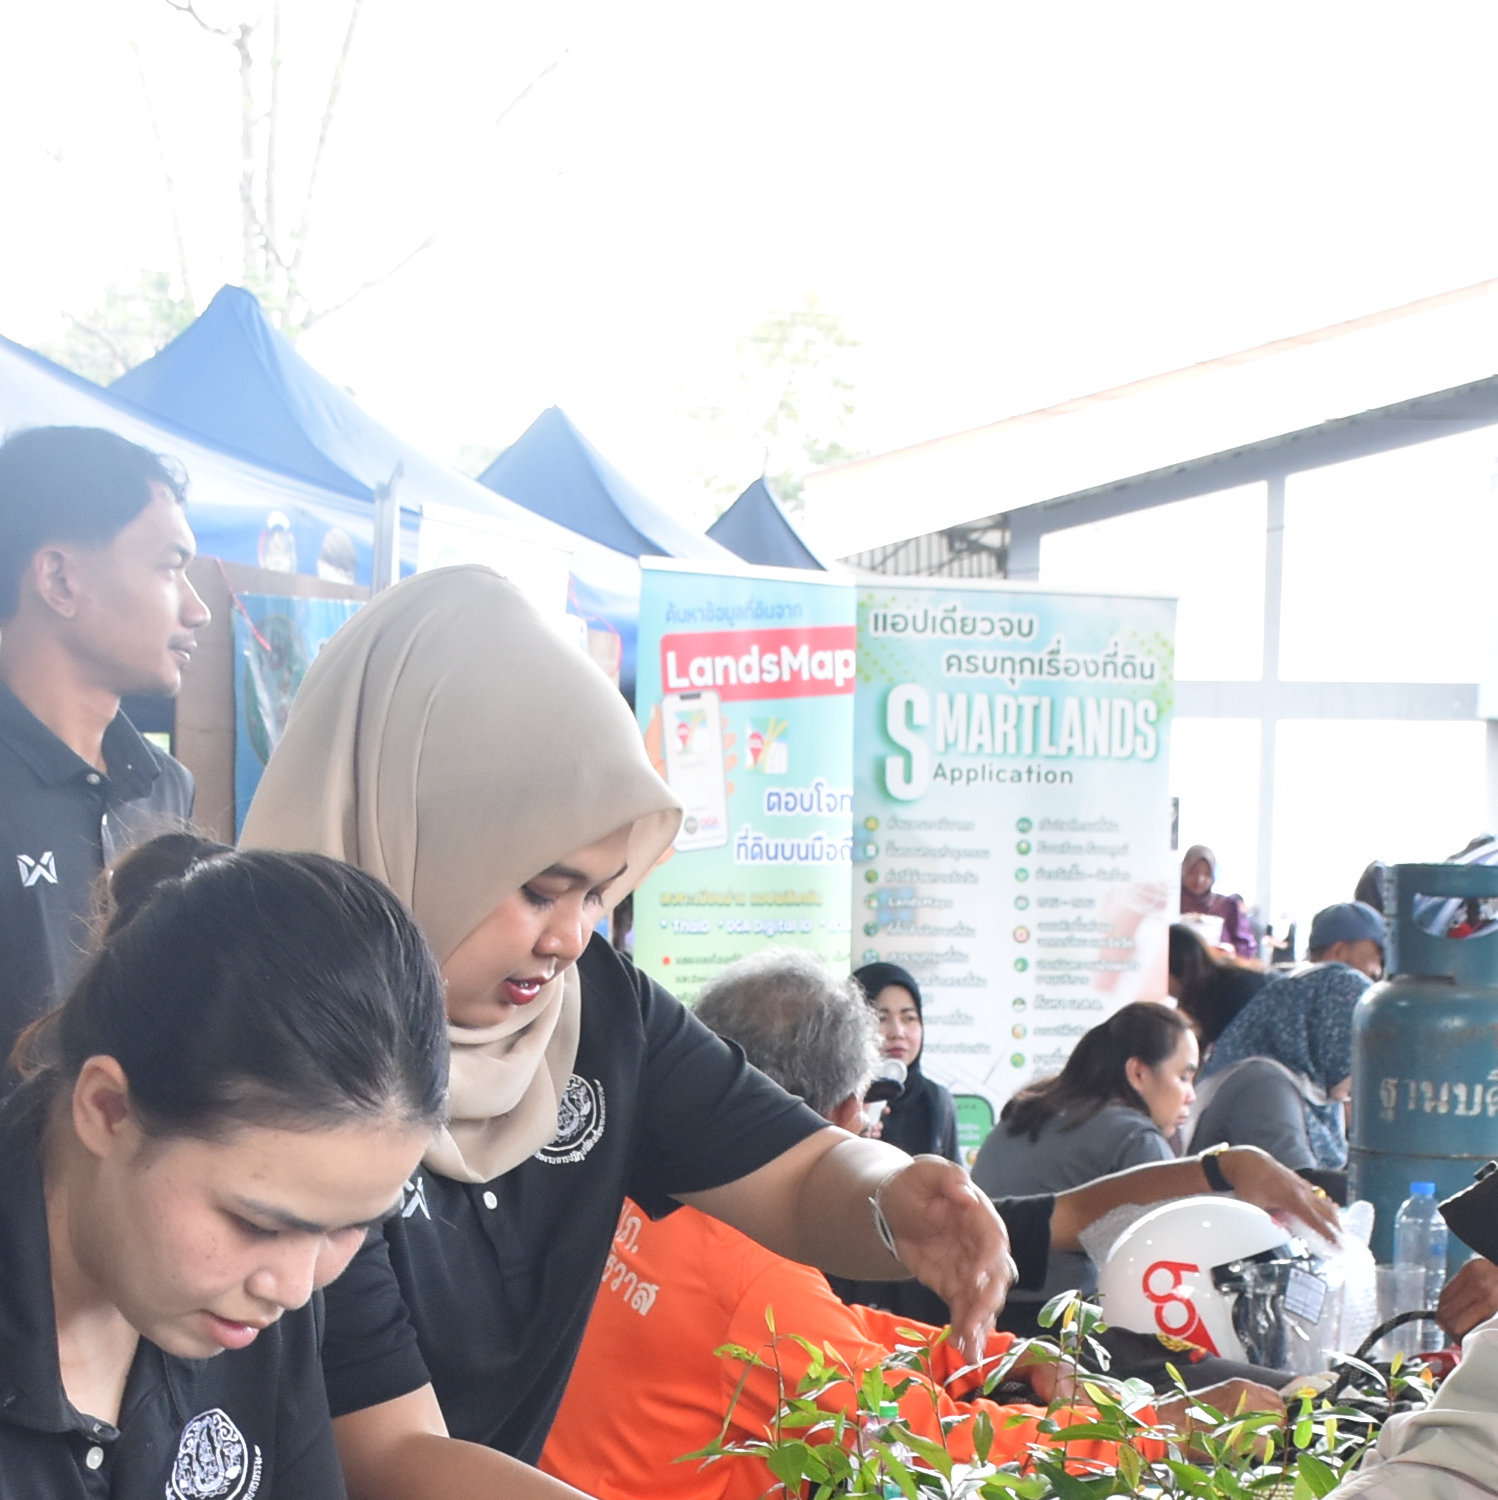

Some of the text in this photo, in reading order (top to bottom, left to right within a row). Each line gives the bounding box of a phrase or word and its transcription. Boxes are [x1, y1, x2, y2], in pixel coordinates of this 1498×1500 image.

[873, 606, 1034, 637] แอปเดียวจบ
[946, 639, 1155, 685] ครบทุกเรื่องที่ดิน
[933, 763, 1074, 785] Application
